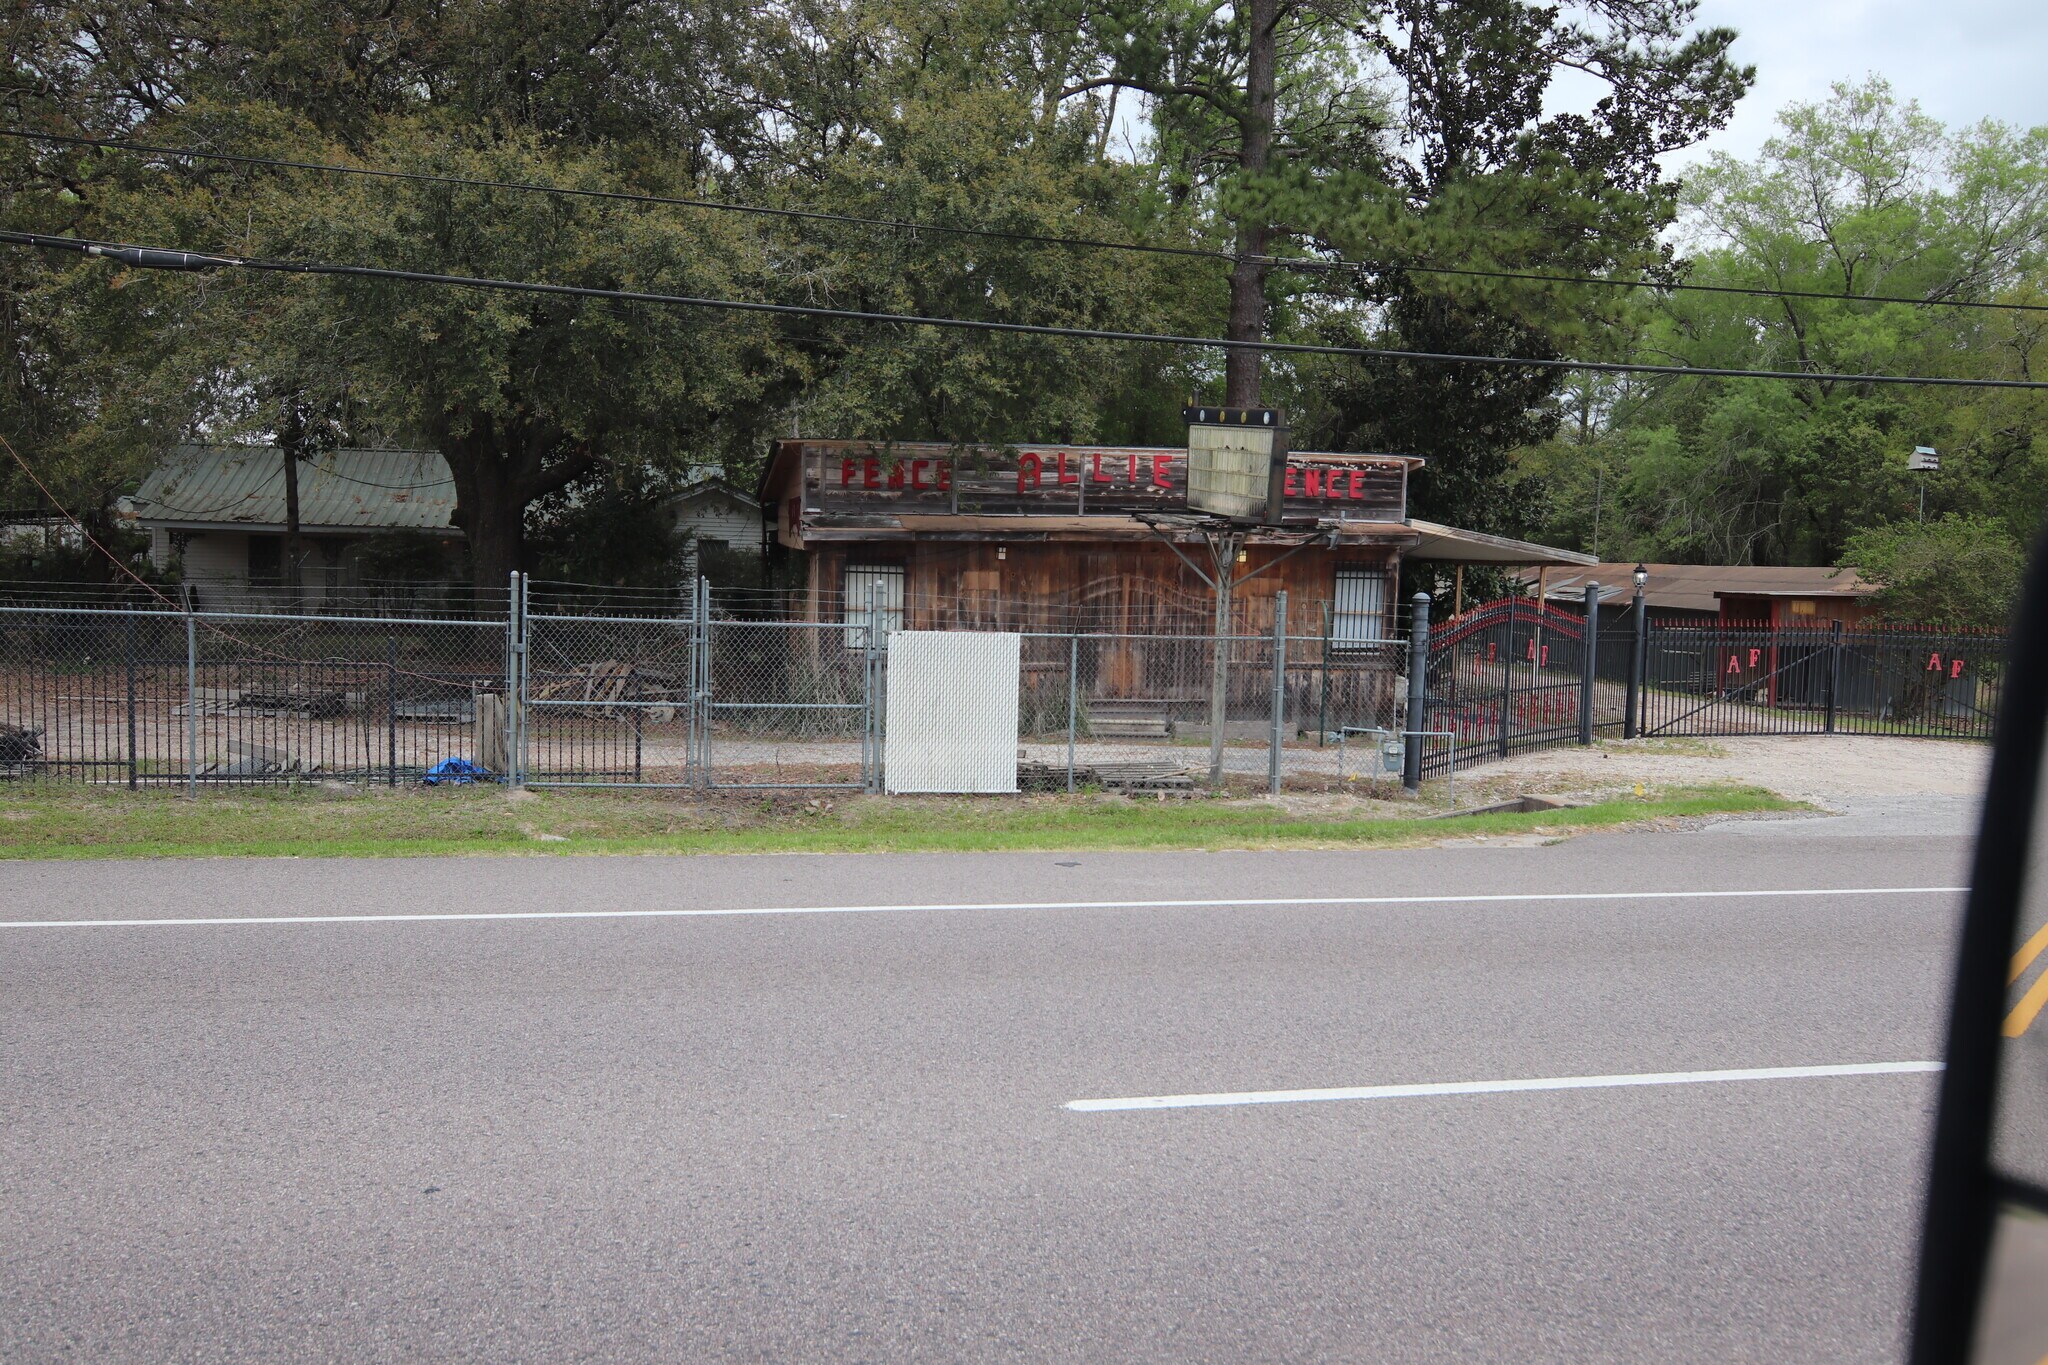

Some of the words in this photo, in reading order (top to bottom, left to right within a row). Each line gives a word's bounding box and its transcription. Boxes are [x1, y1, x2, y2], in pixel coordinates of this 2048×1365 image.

[841, 457, 952, 491] FENCE
[1017, 452, 1175, 493] ALLIE
[1283, 466, 1367, 500] ENCE
